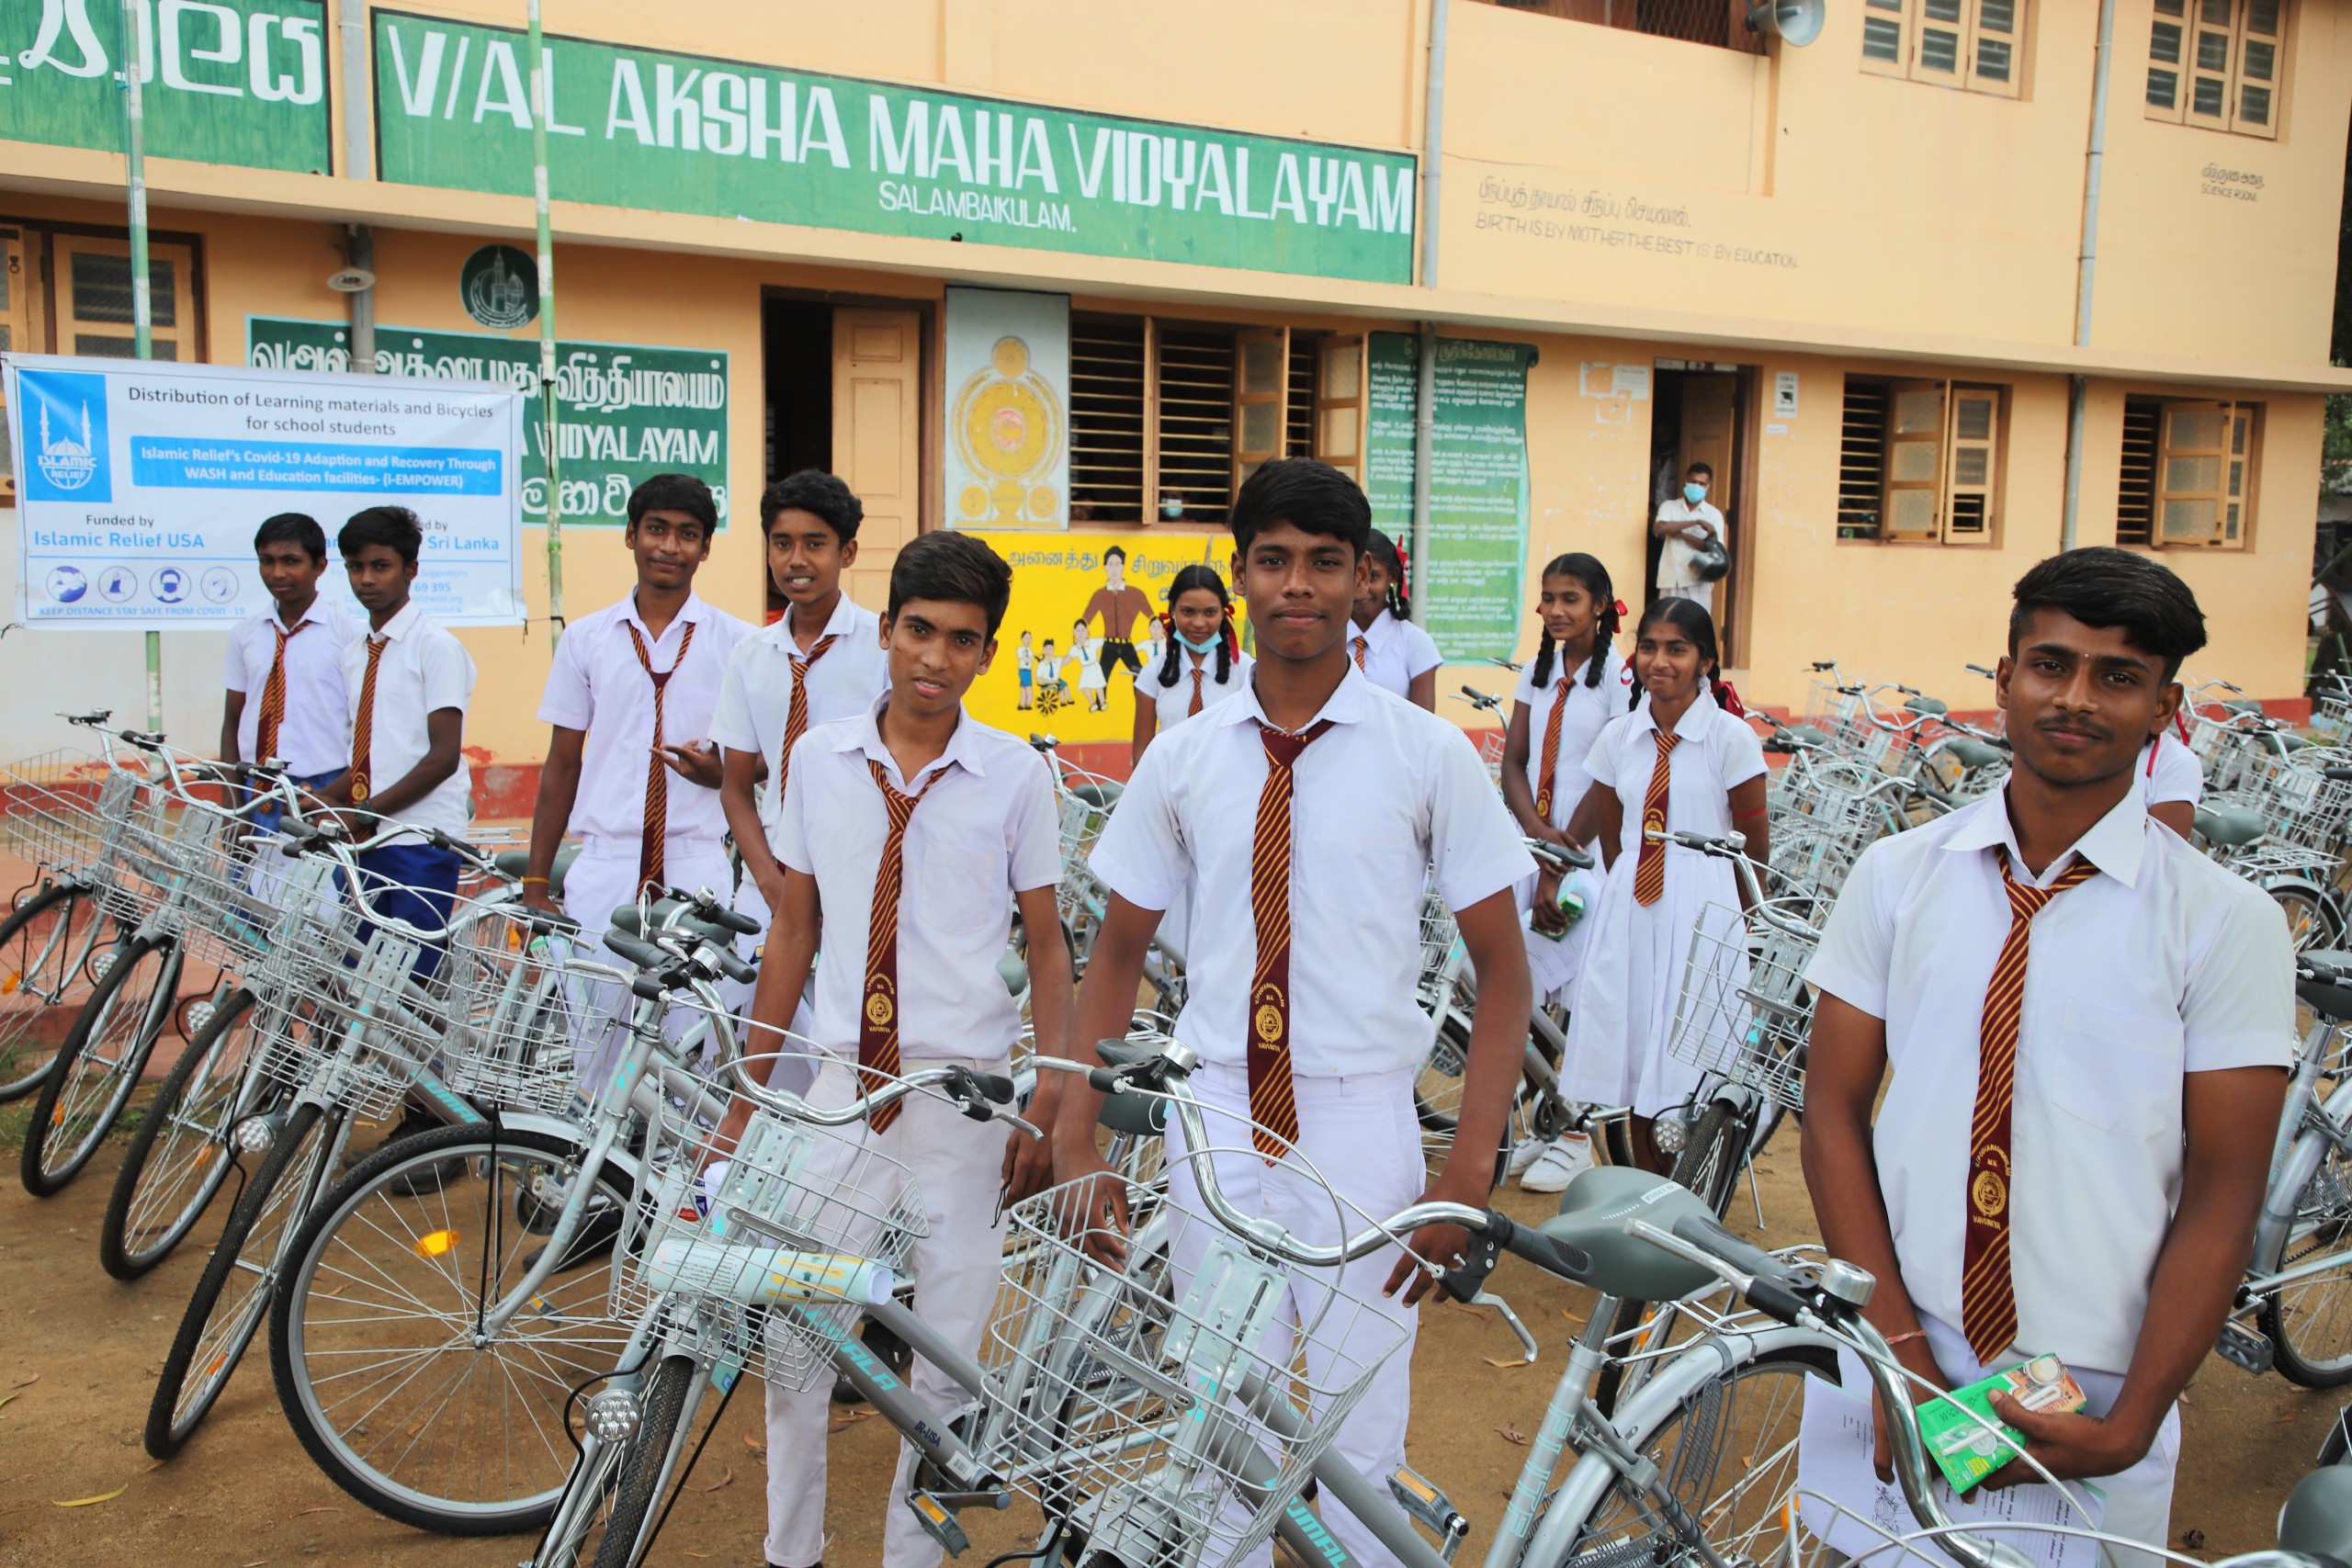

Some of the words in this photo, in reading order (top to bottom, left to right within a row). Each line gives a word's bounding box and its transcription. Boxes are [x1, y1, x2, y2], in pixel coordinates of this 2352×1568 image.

[387, 25, 585, 137] V/AL
[605, 58, 851, 169] AKSHA
[869, 94, 1059, 194] MAHA
[1068, 122, 1415, 235] VIDYALAYAM
[2200, 183, 2233, 198] SCIENCE
[1476, 211, 1527, 234] BIRTH
[1529, 220, 1543, 237] IS
[1544, 221, 1566, 240] BY
[1656, 235, 1694, 255] BEST
[1697, 243, 1711, 257] IS
[1714, 243, 1732, 261] BY
[129, 387, 229, 406] Distribution
[233, 392, 251, 407] of
[255, 393, 323, 412] Learning
[328, 398, 400, 414] materials
[404, 400, 432, 415] and
[437, 402, 494, 419] Bicycles
[246, 415, 269, 431] for
[274, 417, 325, 434] school
[330, 420, 397, 436] students
[141, 446, 189, 461] Islamic
[193, 448, 241, 462] Relief's
[243, 450, 300, 466] Covid-19
[303, 452, 362, 468] Adaption
[365, 455, 389, 468] and
[391, 456, 445, 471] Recovery
[447, 457, 496, 472] Through
[185, 467, 226, 480] WASH
[230, 468, 254, 480] and
[258, 468, 322, 483] Education
[382, 472, 463, 488] (i-EMPOWER)
[86, 514, 135, 526] Funded
[139, 514, 154, 528] by
[435, 520, 448, 532] by
[34, 531, 103, 547] Islamic
[109, 533, 163, 547] Relief
[167, 534, 205, 548] USA
[427, 536, 450, 549] Sri
[455, 537, 500, 550] Lanka
[432, 582, 451, 592] 395
[40, 607, 64, 615] KEEP
[66, 607, 113, 615] DISTANCE
[116, 607, 138, 615] STAY
[141, 607, 163, 615] SAFE
[165, 607, 194, 615] FROM
[197, 607, 226, 615] COVID
[234, 607, 245, 615] 19
[914, 1420, 942, 1448] IR-USA
